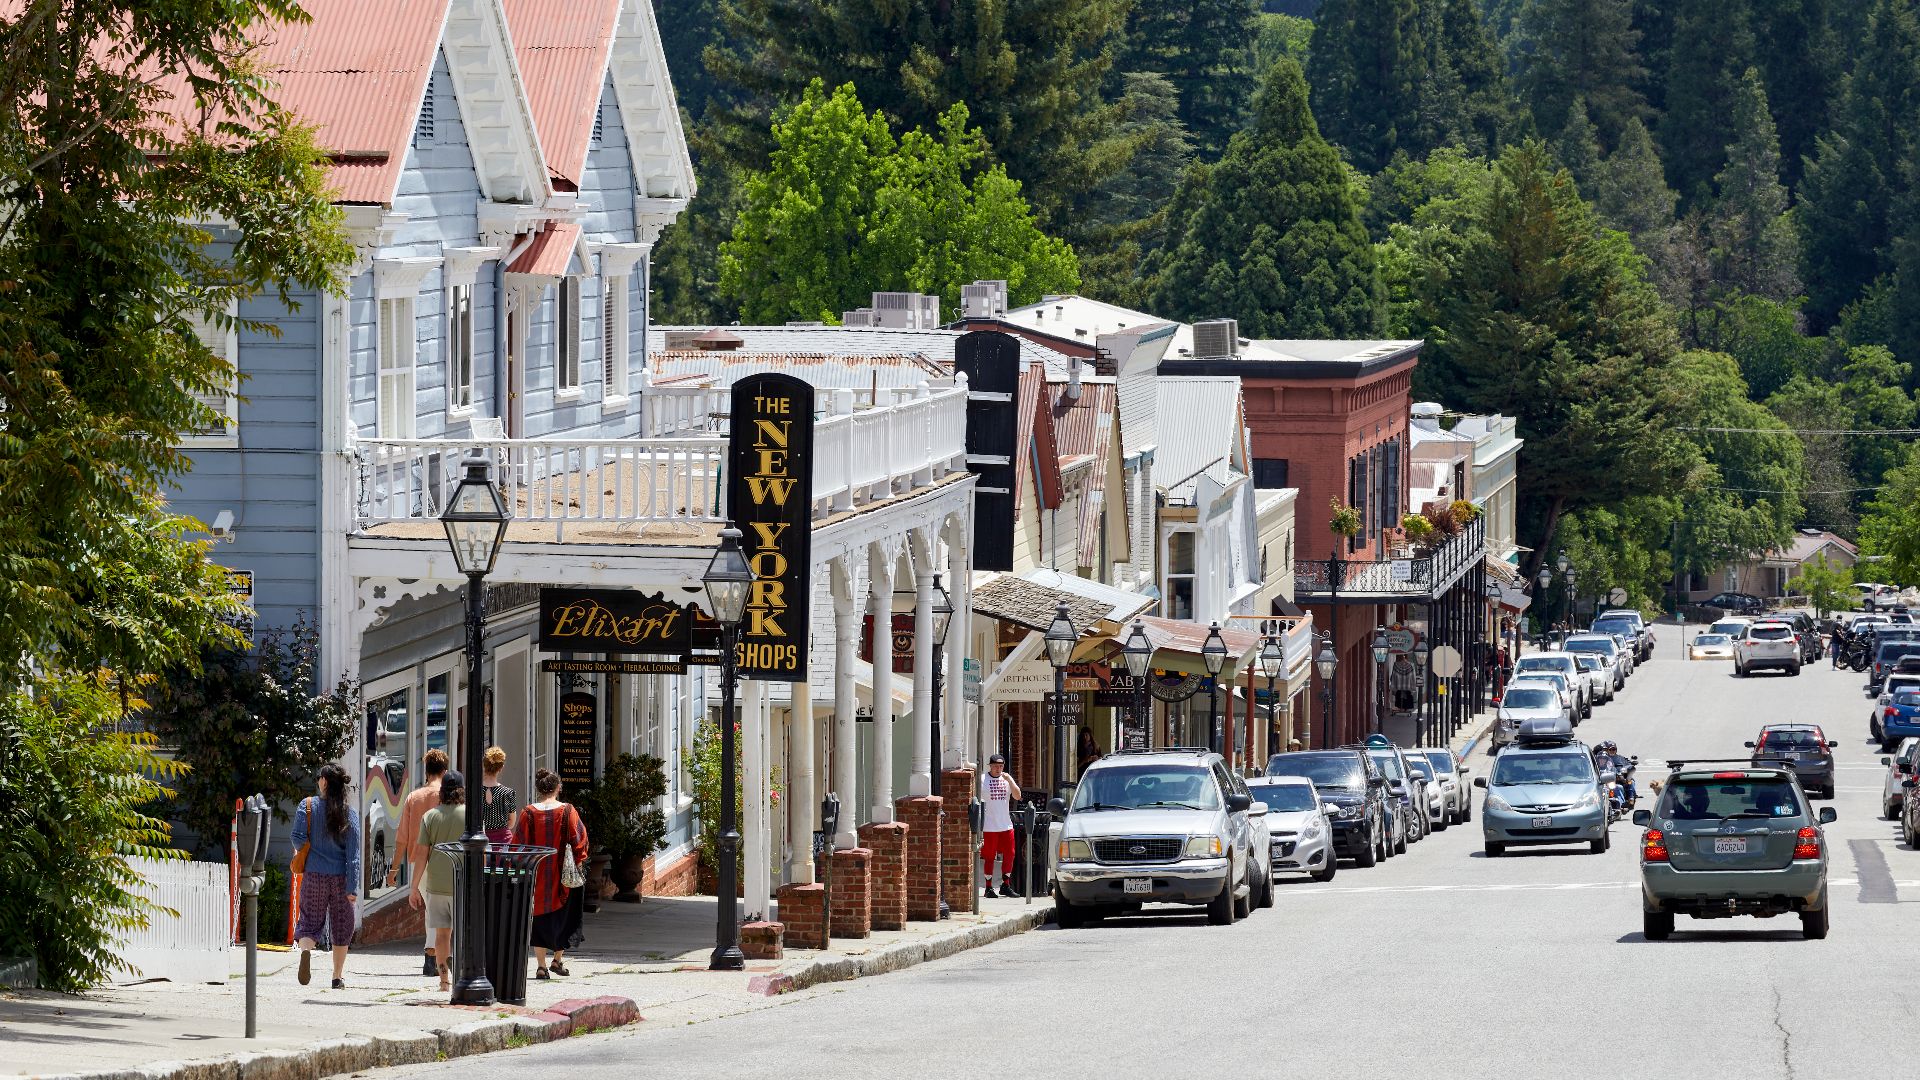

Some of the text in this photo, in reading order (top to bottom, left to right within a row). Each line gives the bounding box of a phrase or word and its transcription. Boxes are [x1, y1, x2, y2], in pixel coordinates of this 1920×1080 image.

[754, 396, 790, 414] THE
[743, 420, 798, 637] NEW YORK
[550, 598, 681, 645] Elixart
[736, 643, 797, 669] SHOPS
[548, 661, 681, 672] ART TASTING ROOM HERBAL LOUNGE
[1070, 680, 1091, 689] YORK
[1069, 694, 1079, 702] TO
[563, 703, 592, 713] Shops
[1047, 704, 1080, 713] PAKING
[1051, 715, 1076, 725] SOPS
[564, 758, 590, 766] SAVVY
